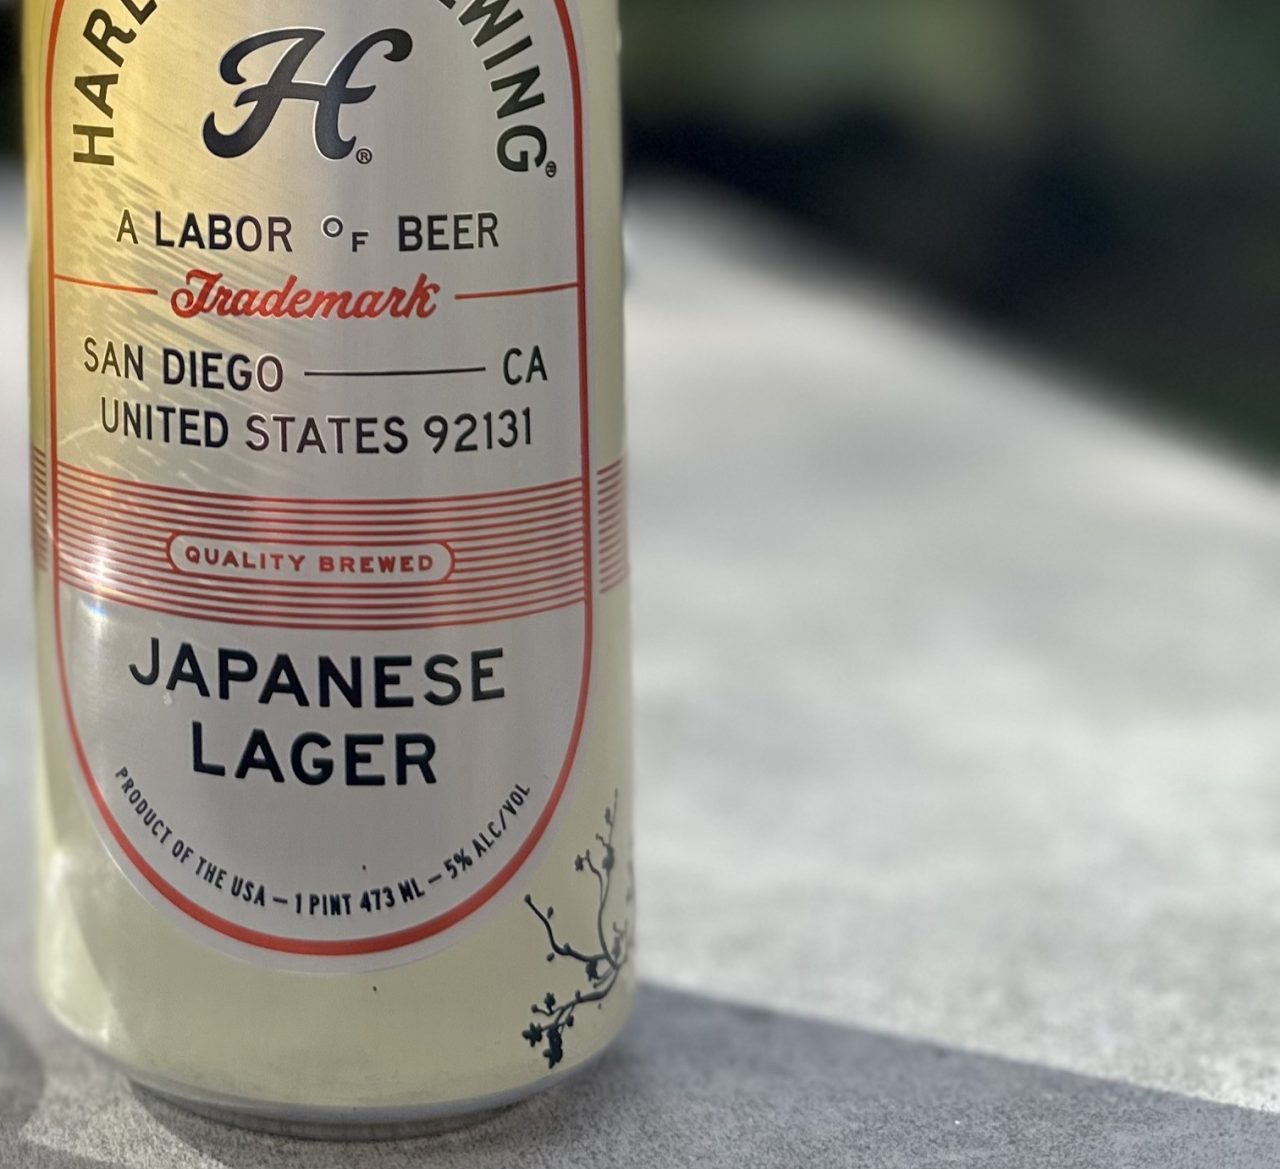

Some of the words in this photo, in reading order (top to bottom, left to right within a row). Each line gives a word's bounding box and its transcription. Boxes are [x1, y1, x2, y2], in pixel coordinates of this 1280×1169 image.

[116, 210, 138, 244] A
[155, 211, 293, 252] LABOR
[322, 215, 368, 252] OF
[398, 212, 499, 252] BEER
[170, 269, 440, 319] Trademark
[84, 337, 144, 381] SAN
[163, 349, 284, 392] DIEGO
[503, 346, 548, 385] CA
[101, 397, 228, 448] UNITED
[246, 415, 408, 454] STATES
[423, 407, 532, 454] 92131
[185, 545, 305, 572] QUALITY
[319, 555, 433, 572] BREWED
[128, 637, 505, 708] JAPANESE
[192, 720, 437, 786] LAGER
[115, 766, 172, 845] PRODUCT
[171, 840, 193, 863] OF
[194, 856, 225, 889] THE
[230, 878, 267, 907] USA
[295, 893, 302, 914] 1
[309, 893, 352, 915] PINT
[359, 887, 396, 912] 473
[399, 877, 425, 903] ML
[443, 848, 473, 880] 5%
[474, 782, 531, 858] ALC/VOL
